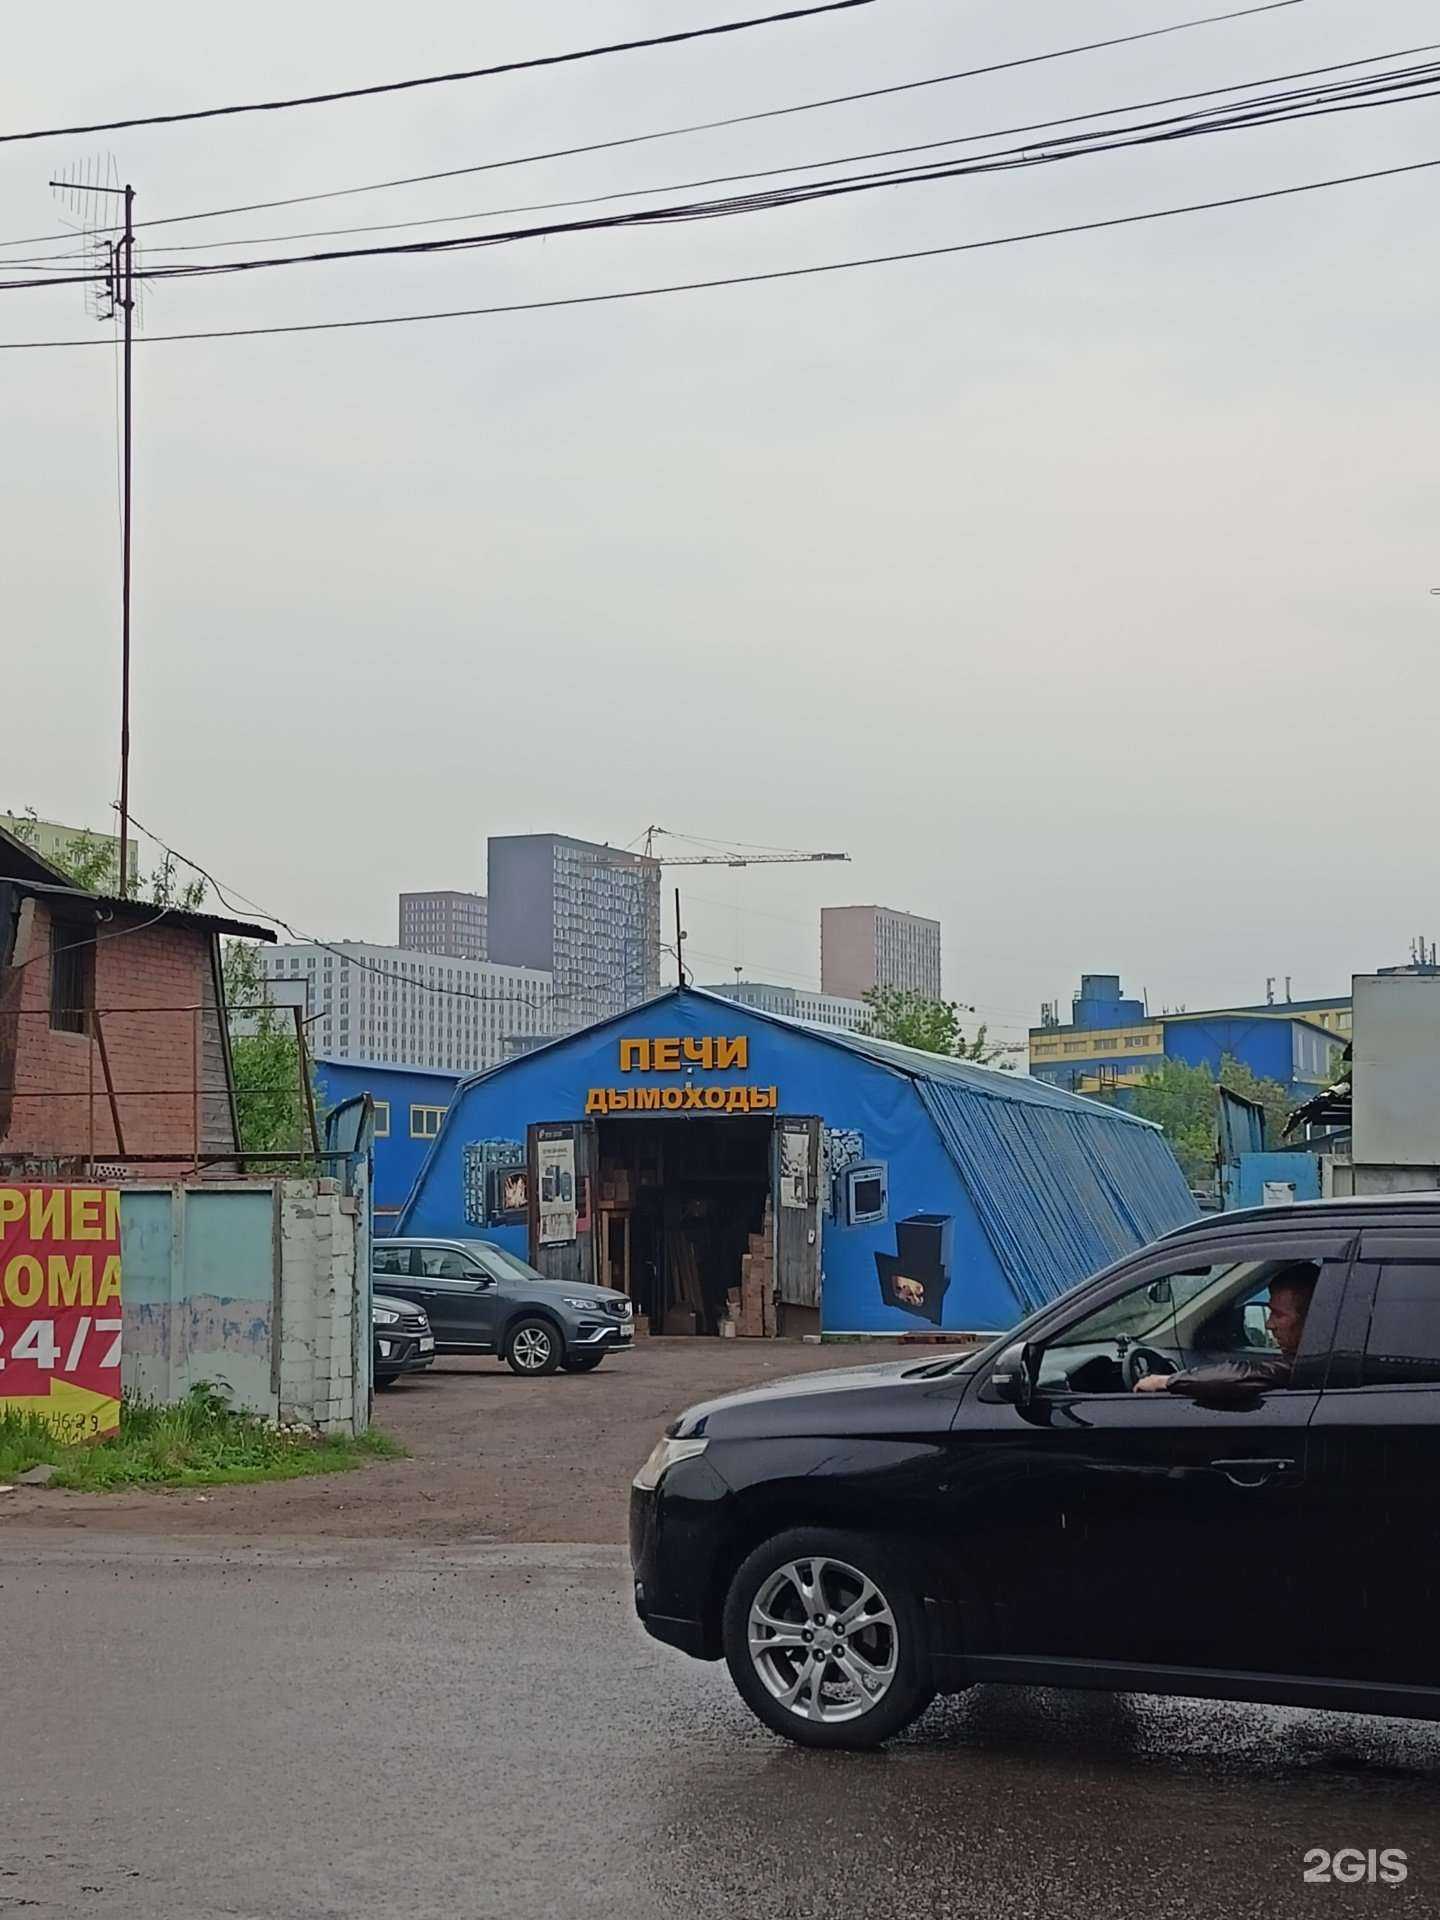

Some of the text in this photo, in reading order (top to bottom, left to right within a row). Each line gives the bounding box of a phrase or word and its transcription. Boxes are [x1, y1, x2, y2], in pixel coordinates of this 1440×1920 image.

[620, 1035, 748, 1072] ПЕЧИ
[585, 1086, 778, 1115] ДЫМОХОДЫ
[0, 1254, 122, 1307] ОМА
[0, 1317, 122, 1371] 4/7
